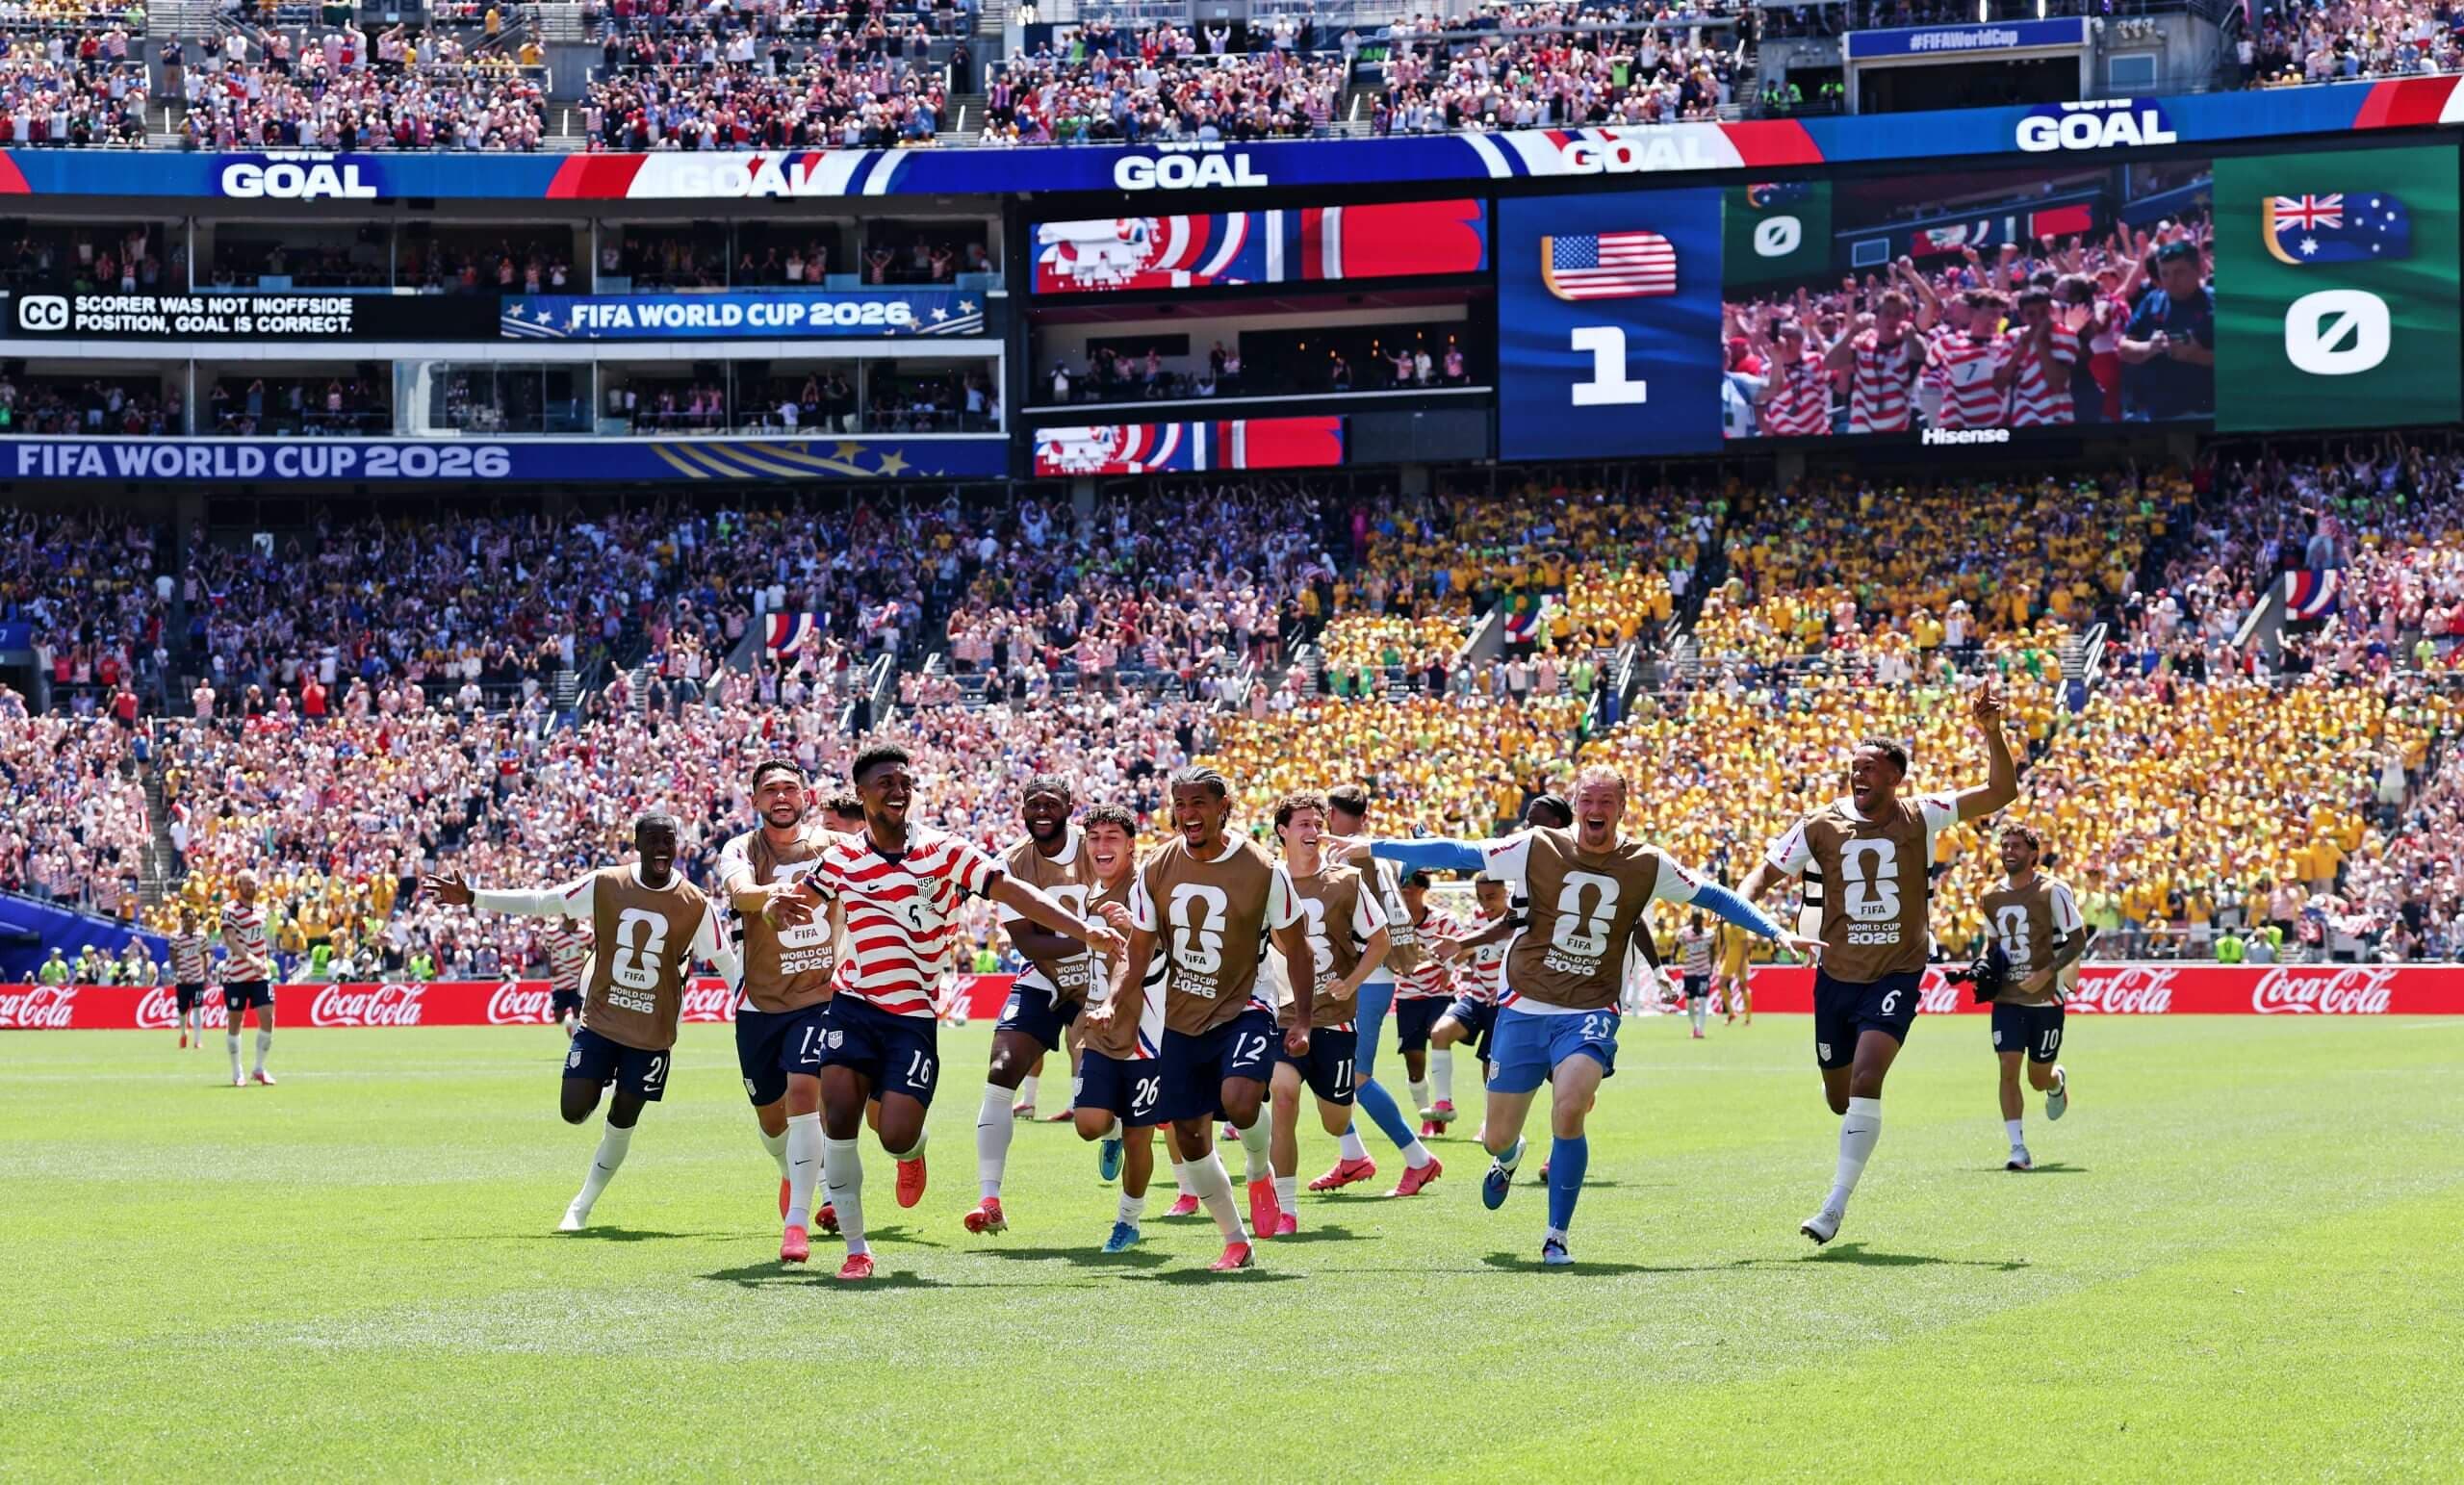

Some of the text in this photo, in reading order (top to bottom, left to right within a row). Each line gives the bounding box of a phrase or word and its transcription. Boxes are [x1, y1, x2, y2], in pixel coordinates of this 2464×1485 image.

[1910, 29, 2018, 50] #FIFAWorldCup
[2015, 110, 2177, 152] GOAL
[1561, 136, 1718, 175] GOAL
[221, 163, 377, 198] GOAL
[675, 163, 825, 197] GOAL
[1114, 153, 1269, 190] GOAL
[24, 301, 63, 325] CC
[75, 295, 353, 315] SCORER WAS NOT INOFFSIDE
[572, 301, 912, 328] FIFA WORLD CUP 2026
[75, 314, 353, 335] POSITION, GOAL IS CORRECT.
[2284, 289, 2391, 375] 0
[1572, 326, 1647, 406] 1
[1922, 427, 2011, 446] Hisense
[17, 444, 512, 478] FIFA WORLD CUP 2026
[1861, 905, 1886, 915] FIFA
[250, 928, 262, 940] 13
[794, 928, 819, 940] FIFA
[1847, 922, 1901, 932] WORLD CUP
[1567, 937, 1592, 951] FIFA
[1847, 932, 1901, 945] 2026
[780, 949, 815, 961] WORLD
[781, 956, 834, 975] 2026
[1185, 953, 1207, 965] FIFA
[1548, 948, 1582, 962] WORLD
[624, 971, 646, 983] FIFA
[1055, 963, 1085, 974] WORLD
[1543, 956, 1597, 977] 2026
[1199, 976, 1219, 986] CUP
[2252, 967, 2400, 1013] Coca-Cola
[310, 984, 427, 1026] Coca-Cola
[607, 992, 654, 1014] 2026
[609, 985, 656, 1003] WORLD CUP
[1881, 988, 1903, 1013] 6
[1579, 1013, 1613, 1039] 25
[1232, 1032, 1268, 1061] 12
[2040, 1028, 2060, 1051] 10
[642, 1056, 669, 1084] 21
[907, 1049, 933, 1085] 16
[1334, 1059, 1352, 1088] 11
[1132, 1076, 1161, 1108] 26
